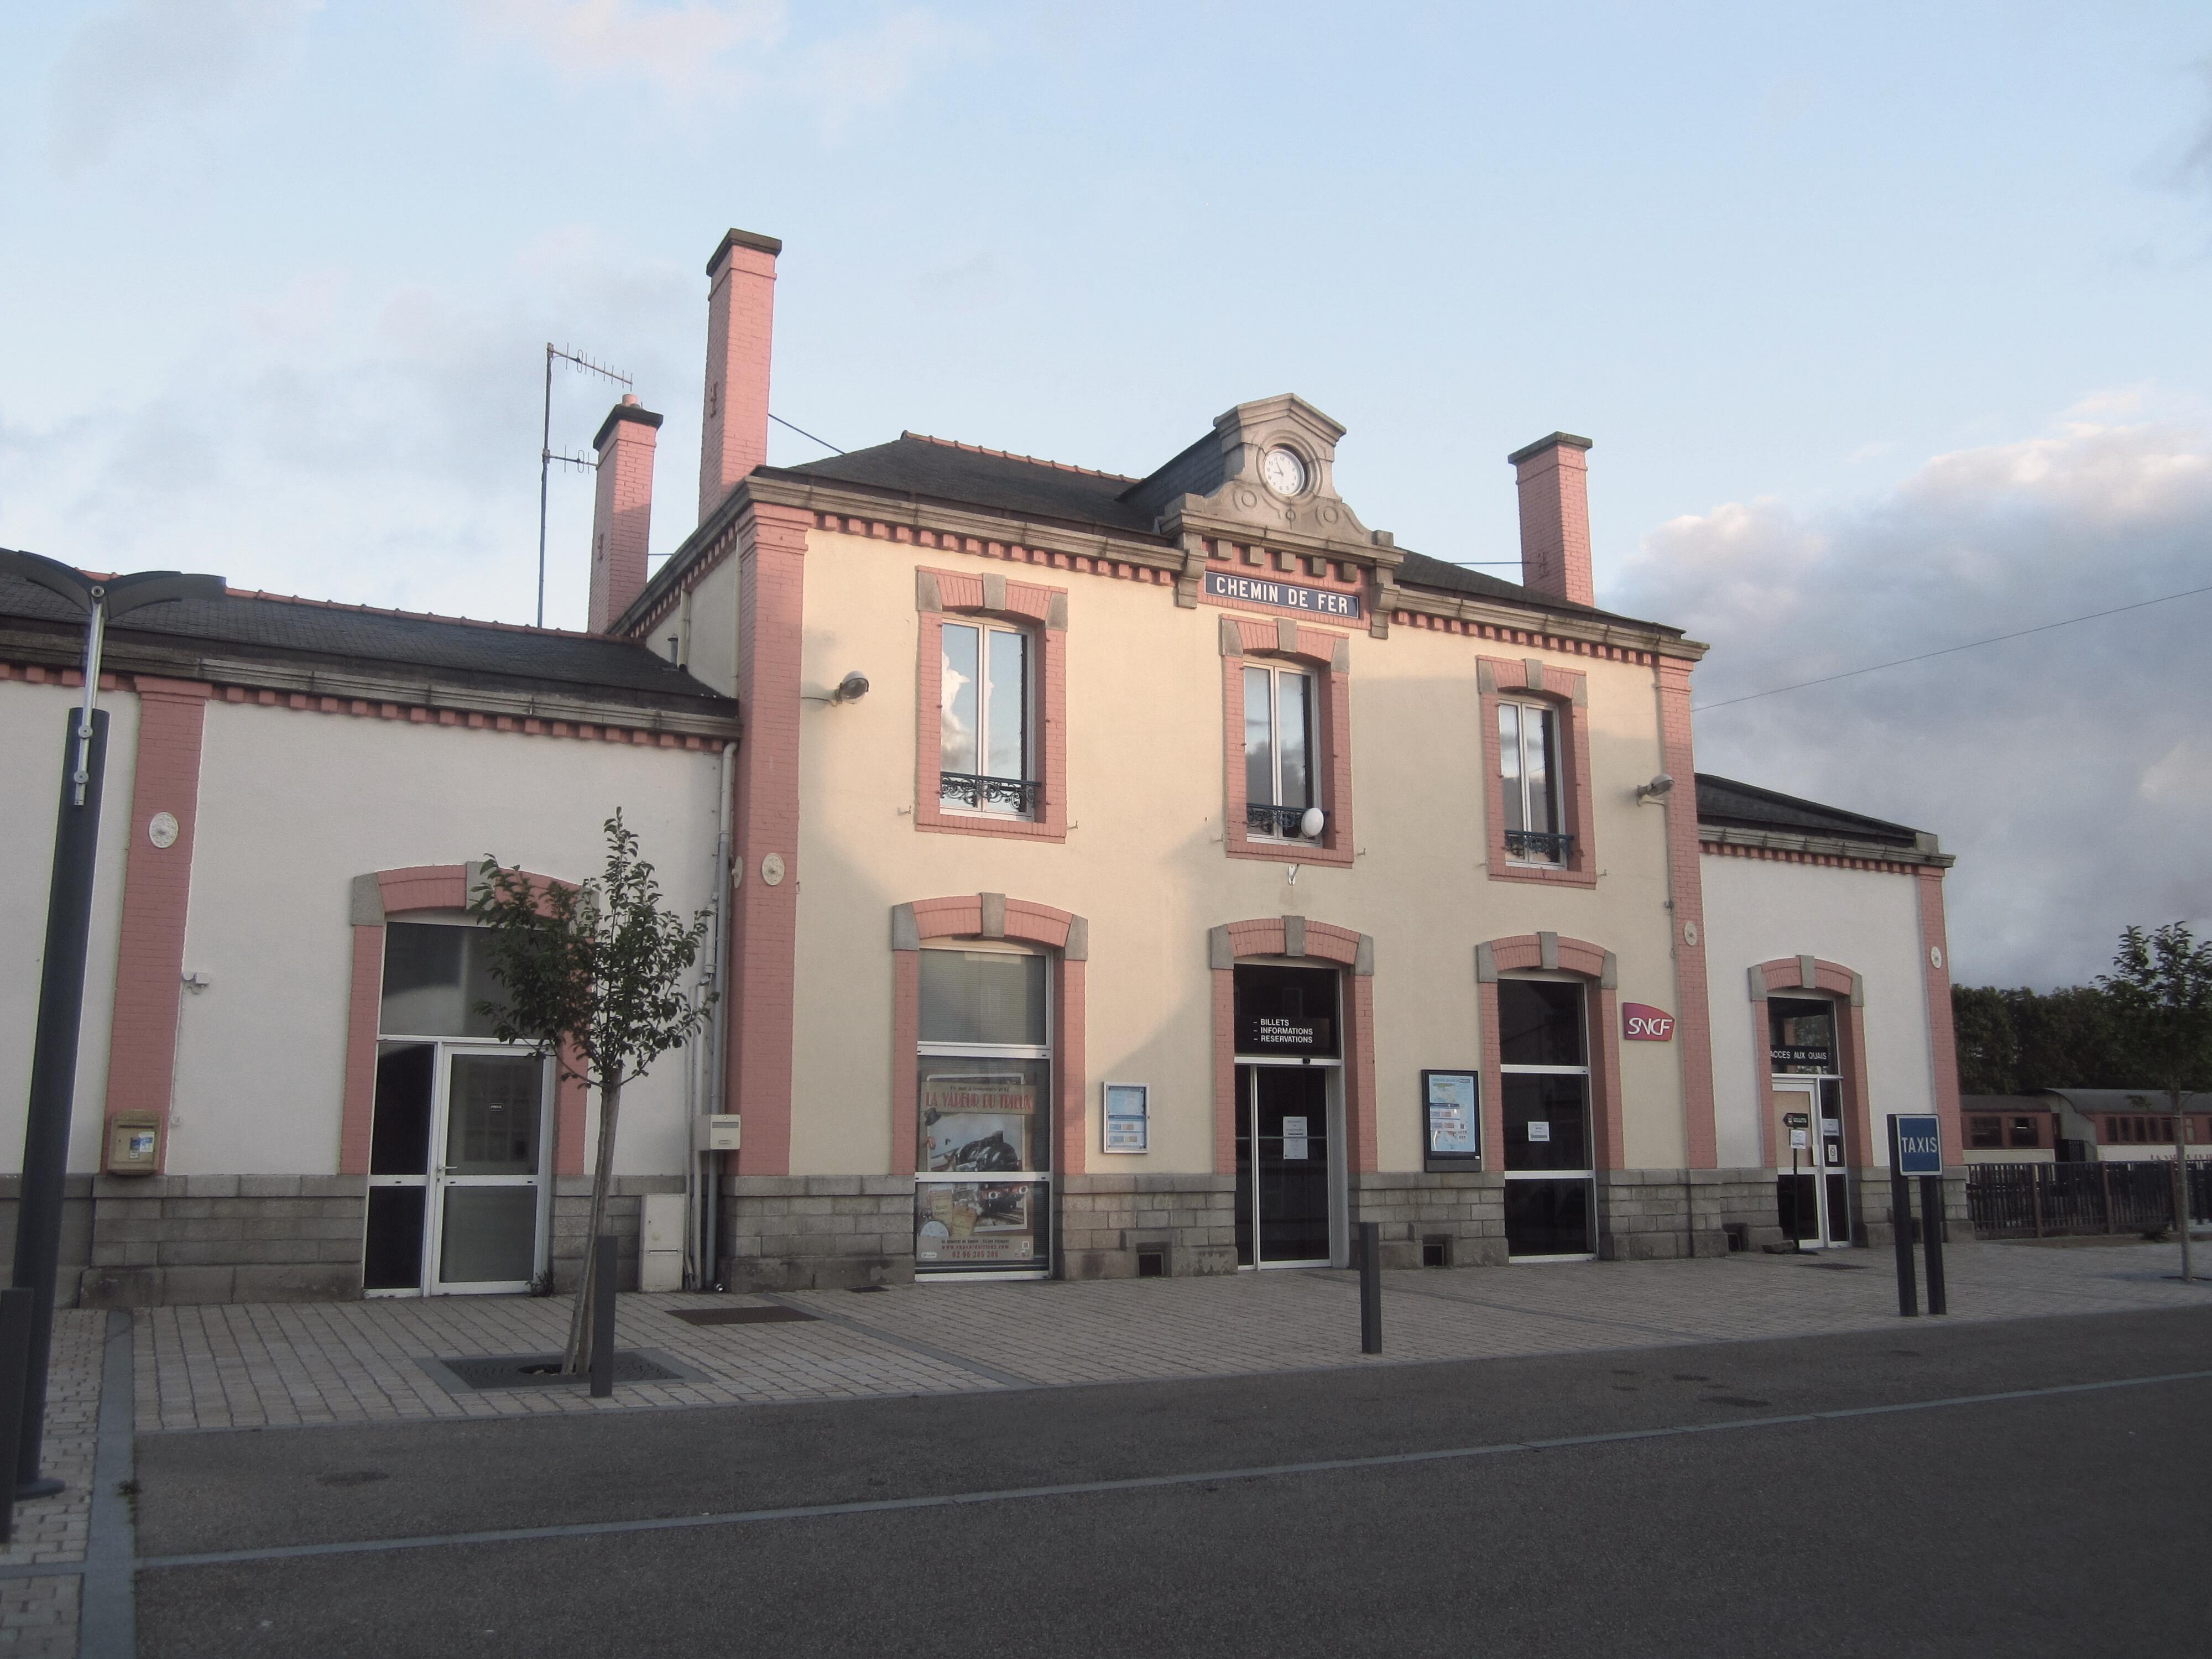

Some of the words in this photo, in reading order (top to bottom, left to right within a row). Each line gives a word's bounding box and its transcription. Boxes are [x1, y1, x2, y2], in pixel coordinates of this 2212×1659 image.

[1216, 577, 1279, 603] CHEMIN
[1288, 589, 1308, 607] DE
[1318, 593, 1348, 614] FER
[1260, 1027, 1313, 1035] INFORMATIONS
[1627, 1017, 1673, 1036] SNCF
[1261, 1035, 1313, 1044] RESERVATIONS
[926, 1092, 938, 1107] LA
[942, 1092, 979, 1108] VAPEUR
[982, 1093, 995, 1109] DU
[1901, 1137, 1937, 1153] TAXIS
